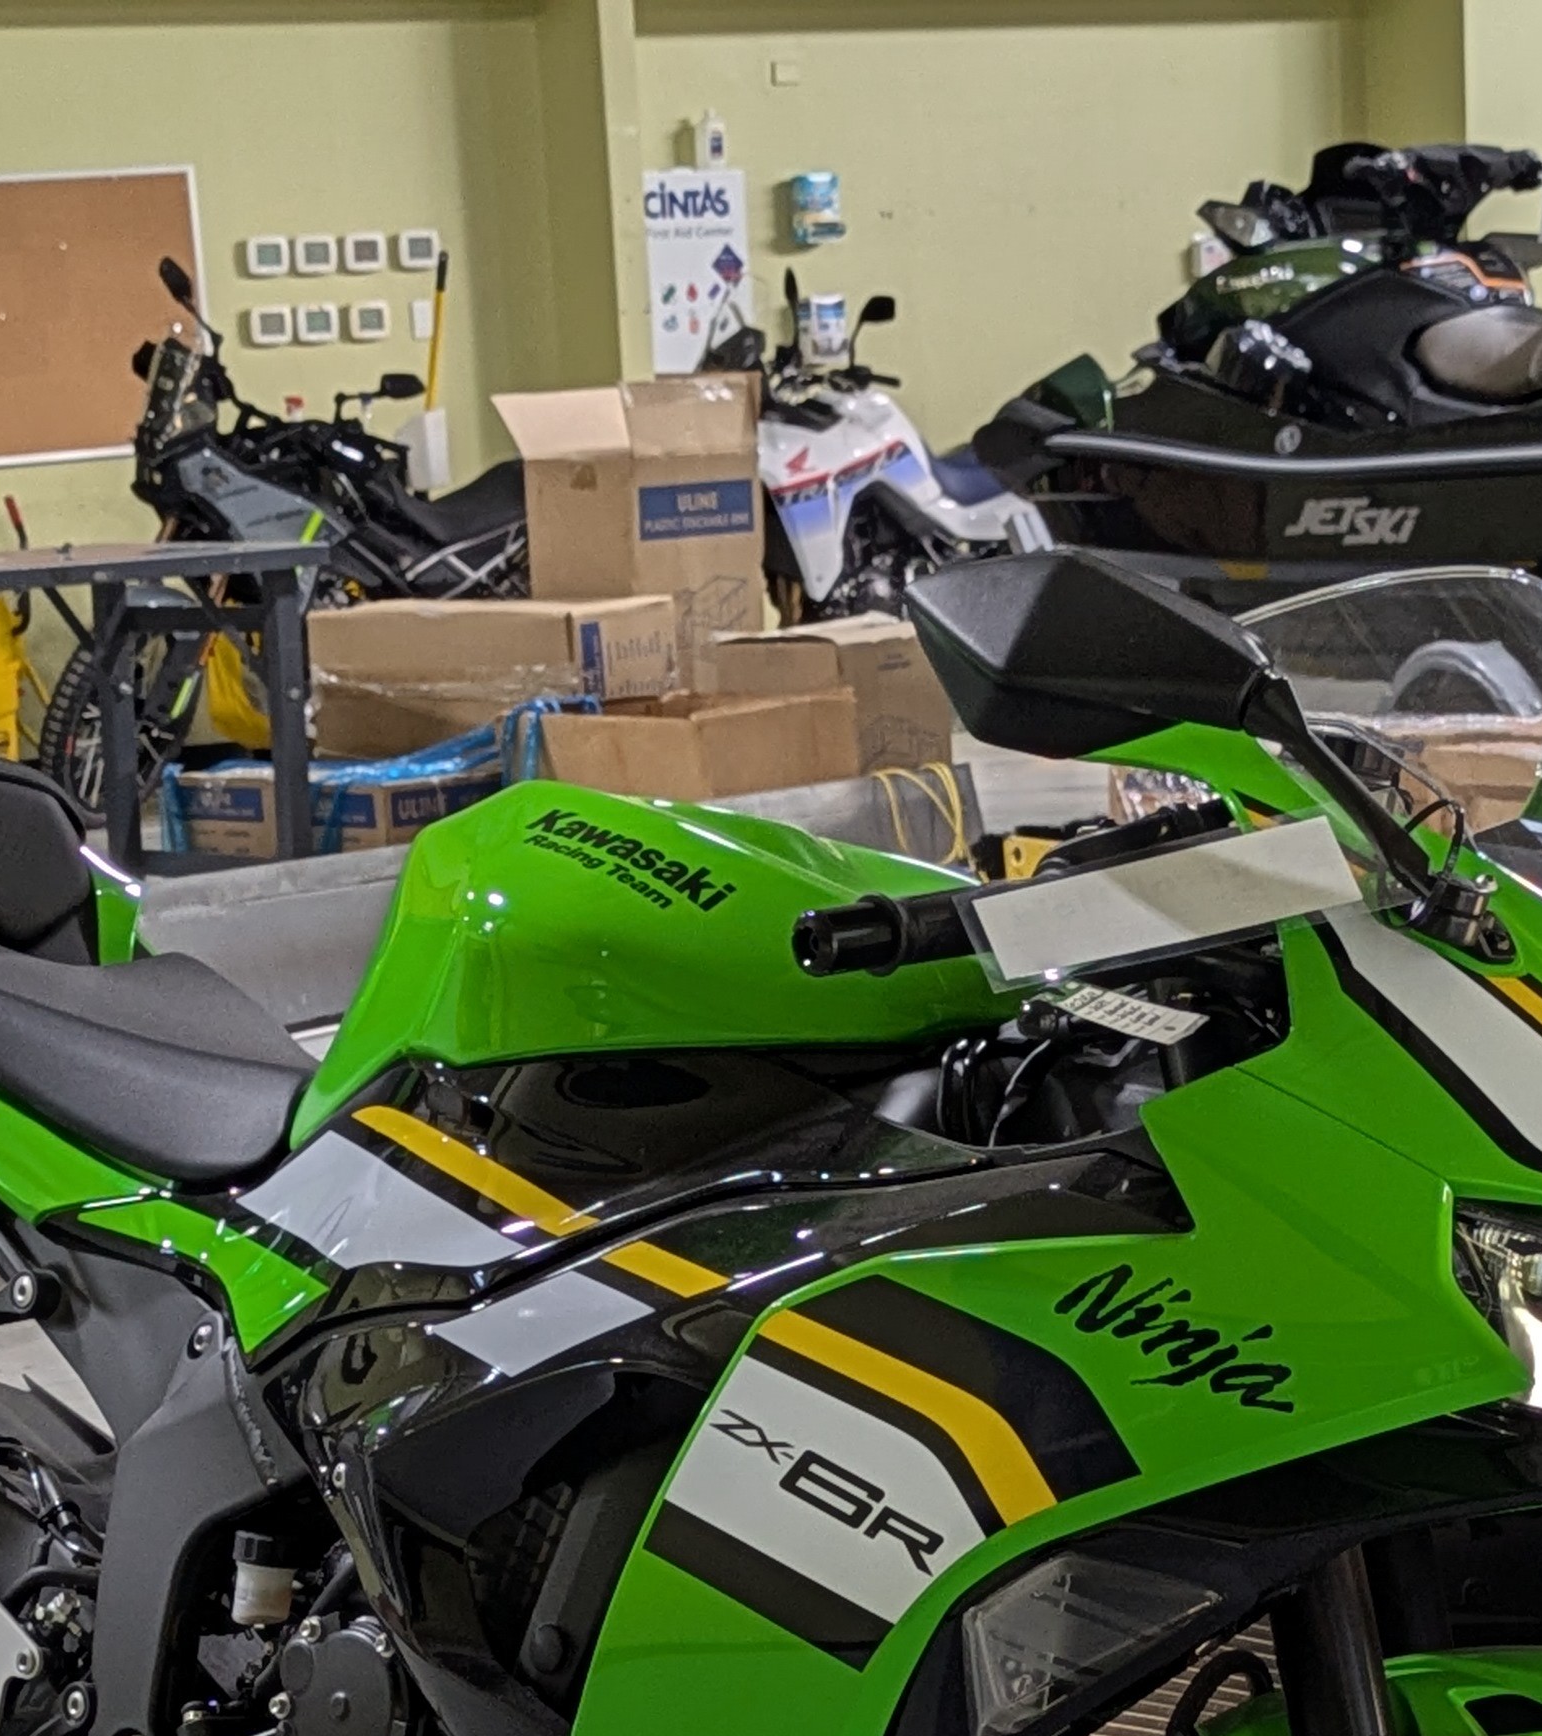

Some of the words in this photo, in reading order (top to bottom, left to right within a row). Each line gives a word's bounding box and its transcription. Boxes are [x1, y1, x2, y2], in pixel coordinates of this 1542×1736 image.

[524, 834, 606, 870] Racing
[606, 863, 673, 910] Team
[525, 809, 737, 912] Kawasaki
[1054, 1263, 1295, 1414] Ninja
[709, 1408, 946, 1577] ZX-6R
